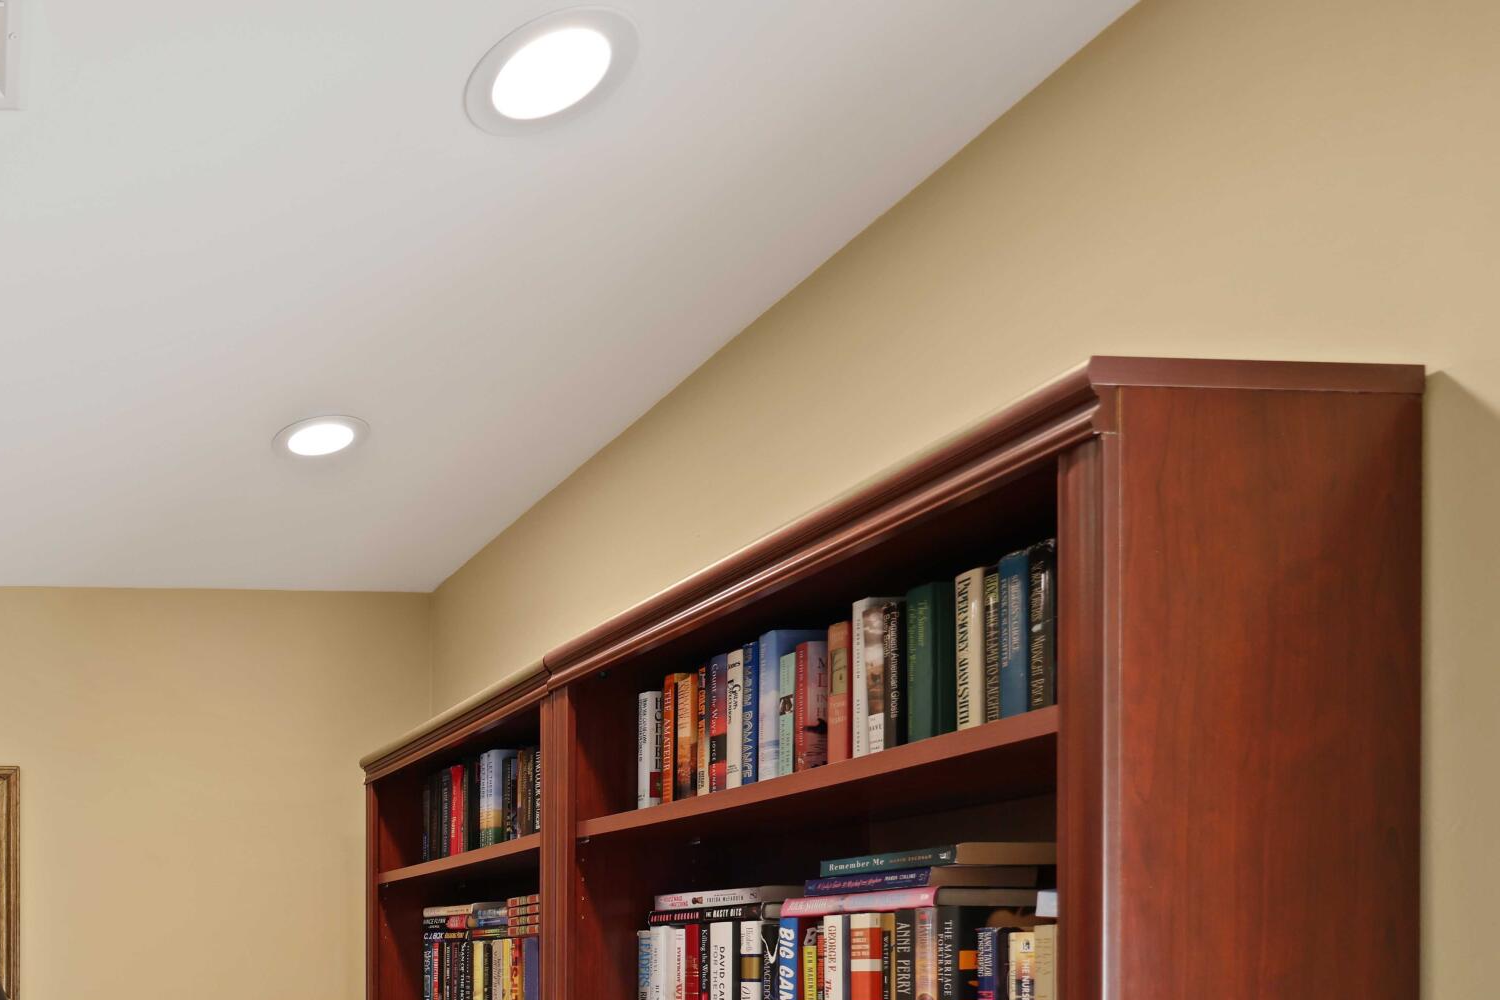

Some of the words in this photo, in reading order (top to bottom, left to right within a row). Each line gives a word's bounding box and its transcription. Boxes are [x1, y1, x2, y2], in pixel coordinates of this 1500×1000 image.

[956, 577, 972, 617] PAPER
[887, 610, 900, 651] Prominent
[957, 617, 970, 653] MONEY
[889, 652, 900, 690] American
[957, 656, 970, 687] ADAM
[663, 689, 672, 712] THE
[889, 690, 900, 720] Ghosts
[957, 687, 971, 726] SMITH
[663, 717, 672, 771] AMATEUR
[829, 859, 870, 872] Remember
[871, 857, 885, 866] Me
[778, 928, 795, 959] BIG
[896, 922, 911, 953] ANNE
[944, 920, 953, 941] THE
[983, 931, 993, 952] NANCY
[640, 936, 651, 988] LEADERS
[896, 959, 911, 995] PERRY
[944, 943, 953, 997] MARRIAGE
[983, 952, 993, 977] TAYLOR
[1021, 958, 1030, 974] THE
[741, 985, 751, 999] ON
